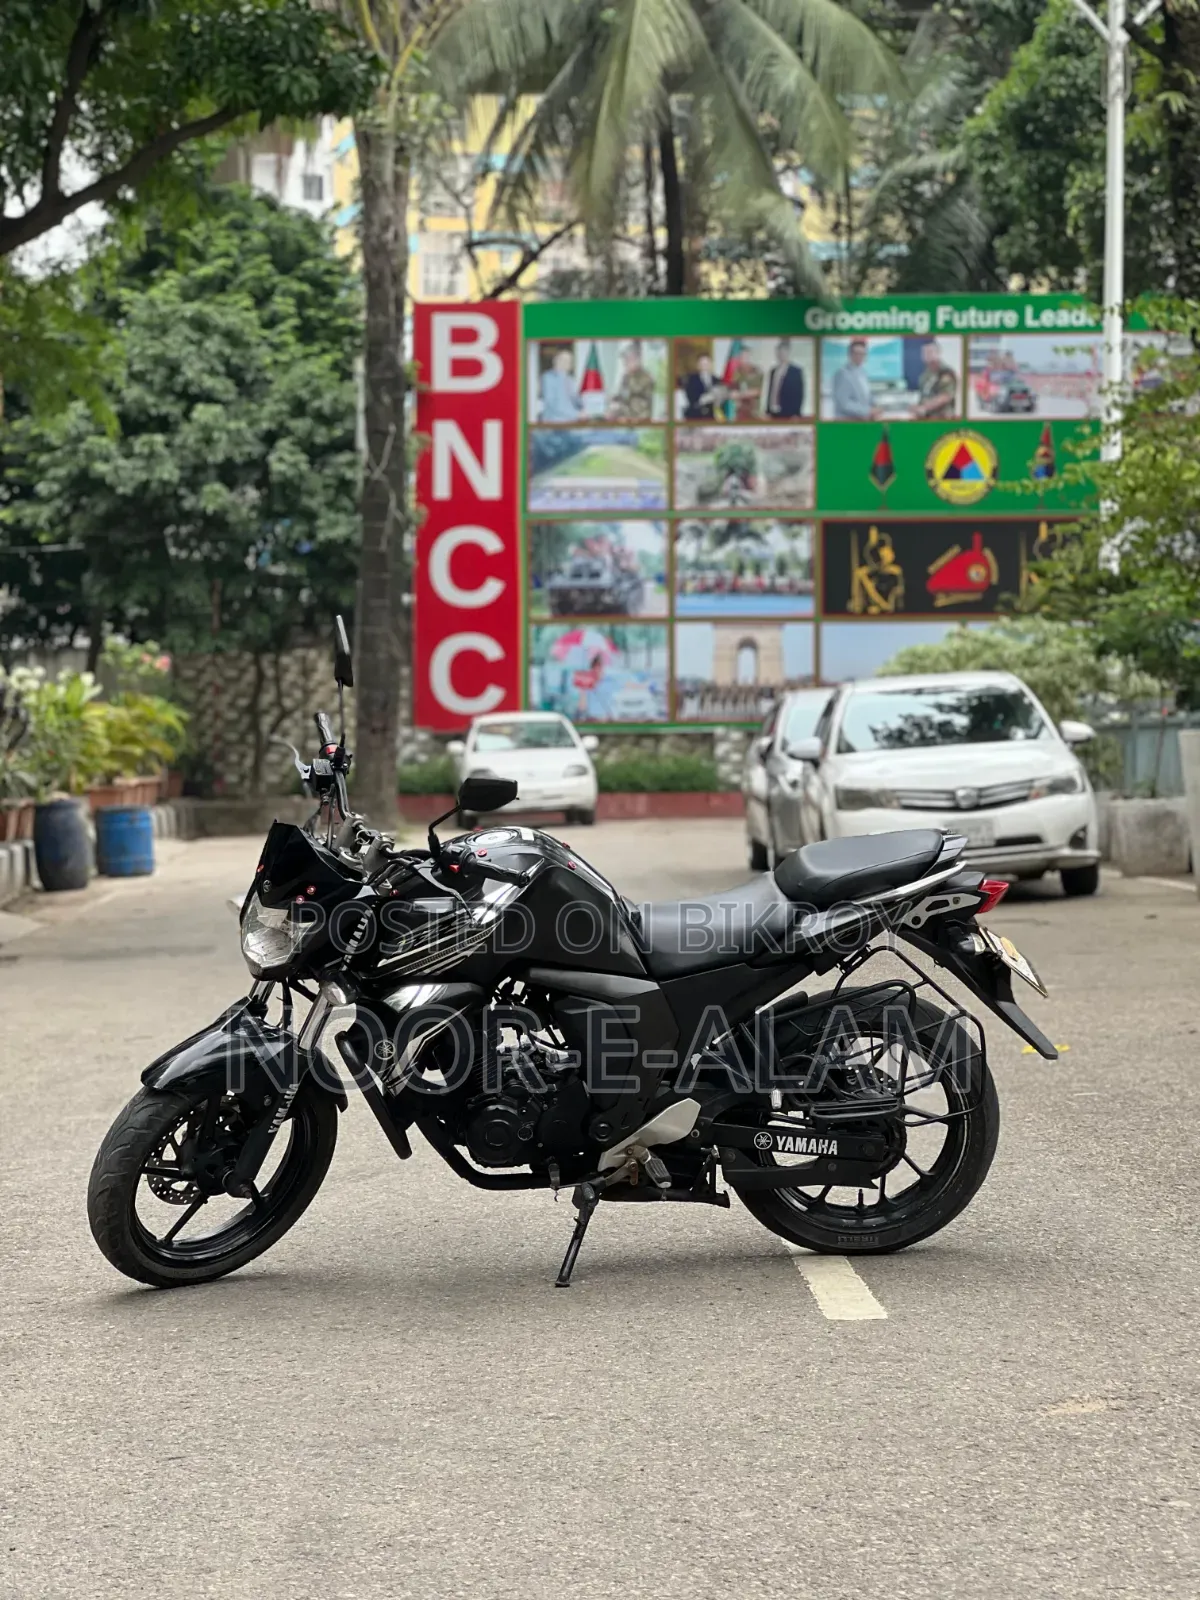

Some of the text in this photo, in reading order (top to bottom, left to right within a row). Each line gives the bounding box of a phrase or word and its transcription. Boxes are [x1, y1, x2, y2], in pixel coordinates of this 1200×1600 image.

[804, 306, 931, 334] Grooming
[936, 305, 1020, 329] Future
[775, 1135, 838, 1155] YAMAHA
